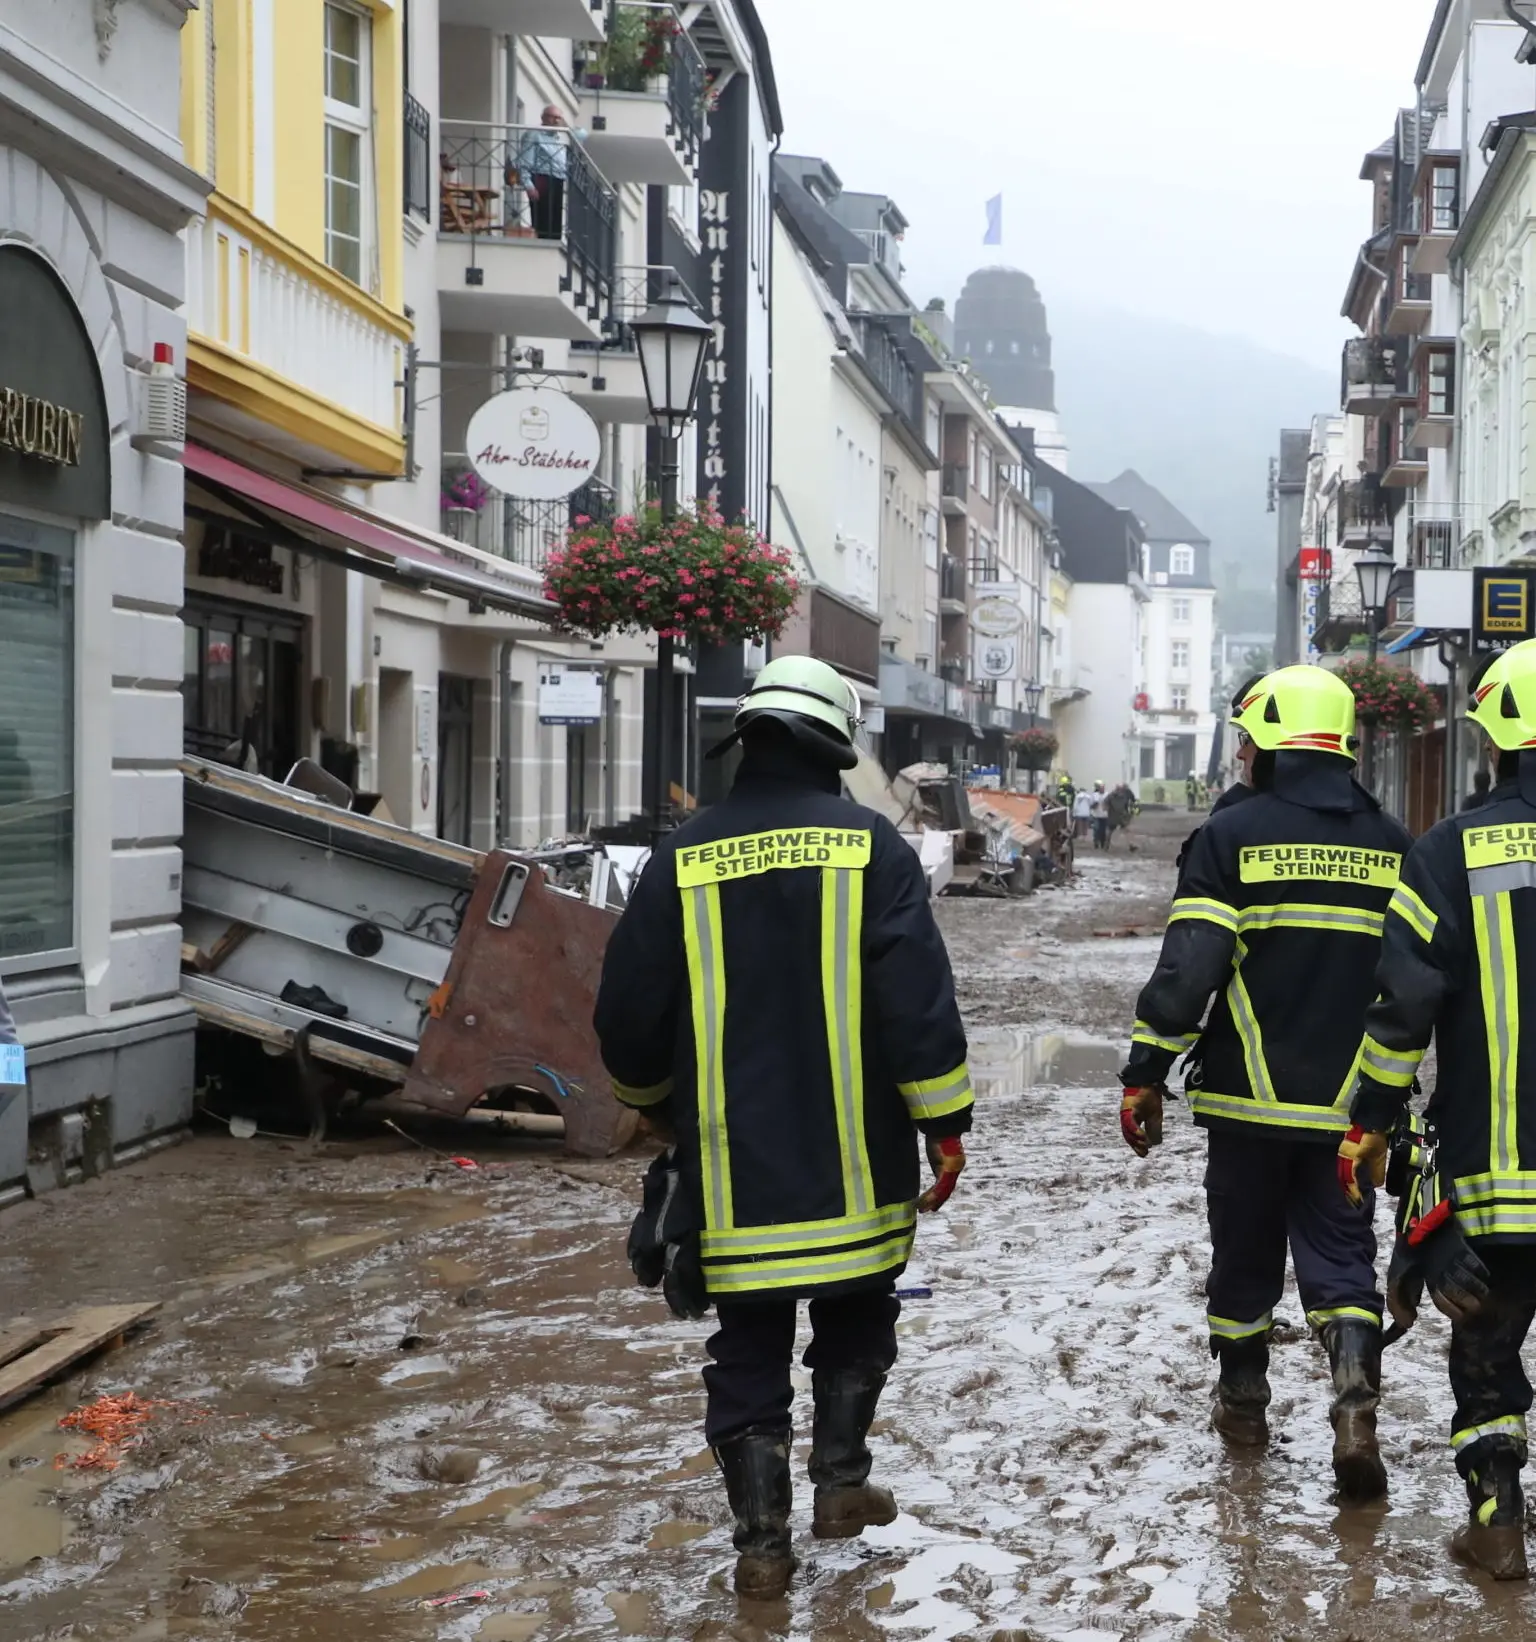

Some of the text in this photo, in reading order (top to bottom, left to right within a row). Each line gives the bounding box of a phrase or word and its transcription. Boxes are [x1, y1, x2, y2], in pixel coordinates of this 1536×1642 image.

[0, 386, 84, 467] RUBIN
[475, 443, 591, 469] Ahr-Stübchen
[1487, 620, 1522, 628] EDEKA
[682, 831, 866, 867] FEUERWEHR
[715, 847, 831, 877] STEINFELD
[1243, 848, 1396, 870] FEUERWEHR
[1273, 863, 1370, 880] STEINFELD
